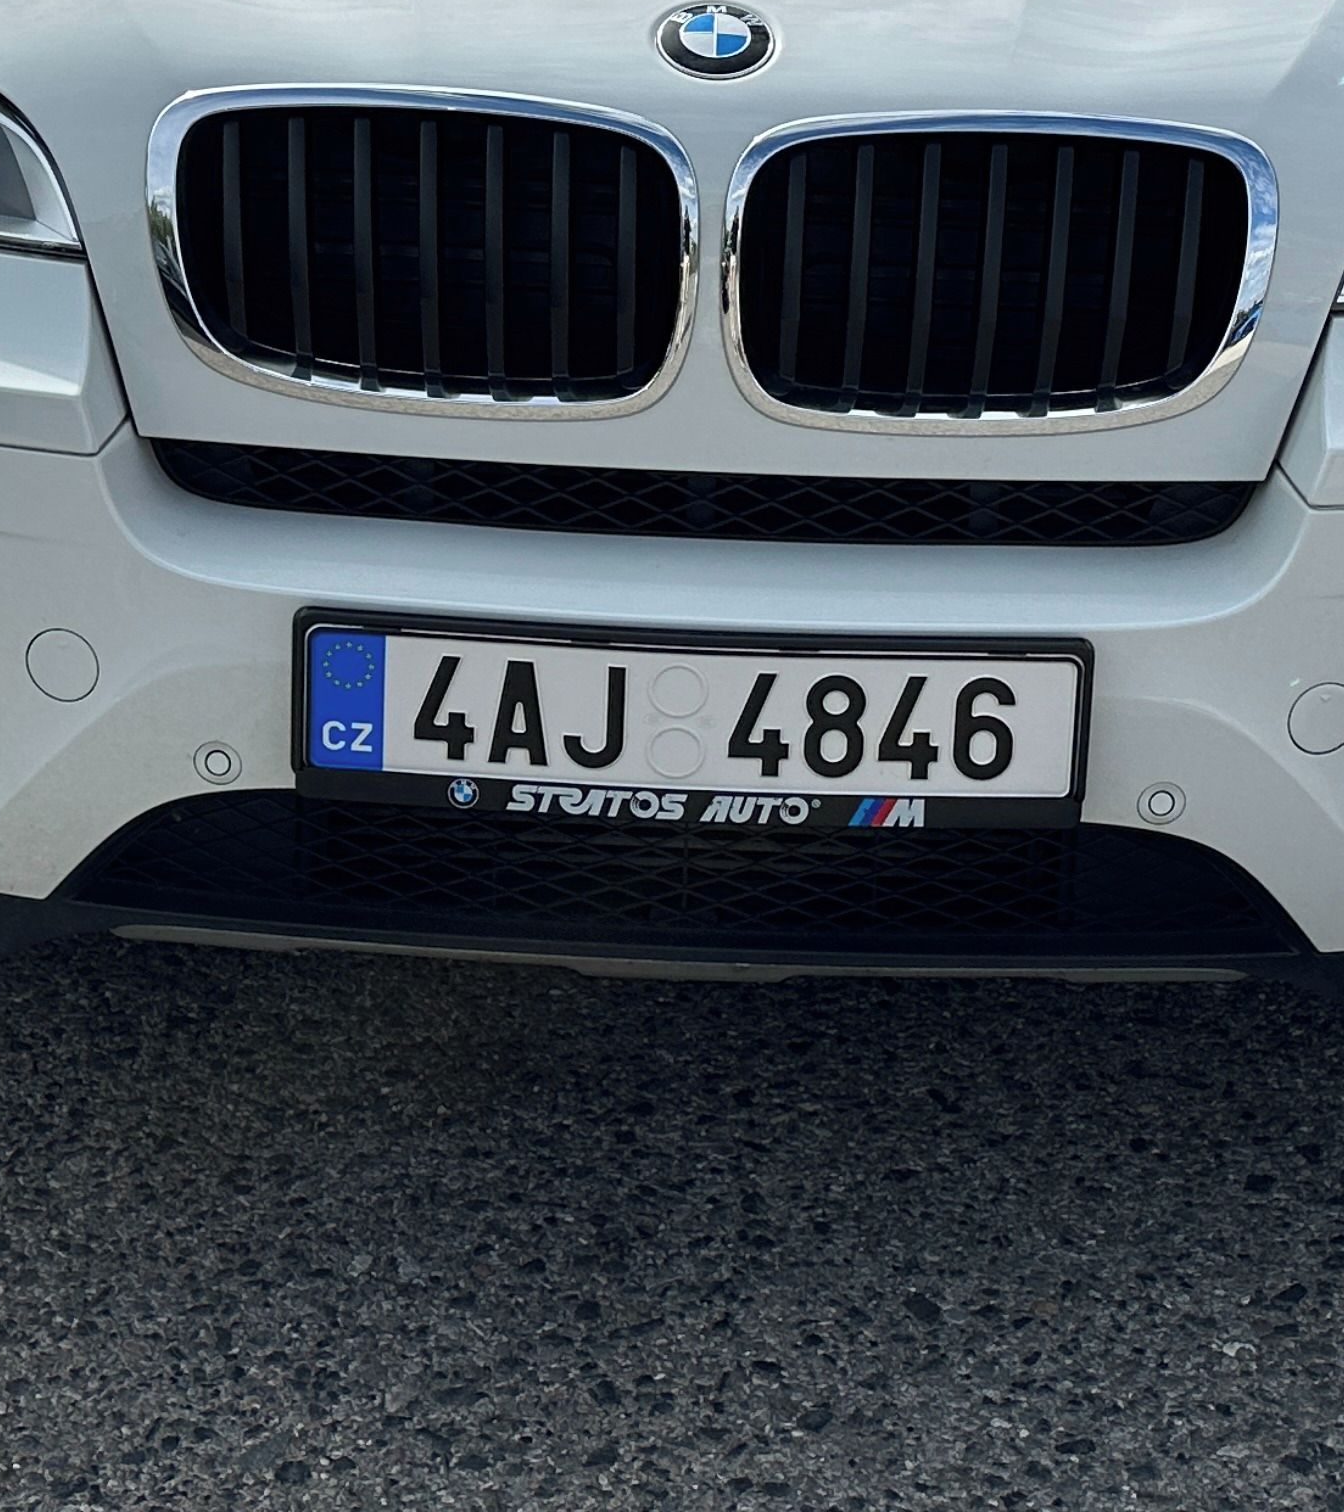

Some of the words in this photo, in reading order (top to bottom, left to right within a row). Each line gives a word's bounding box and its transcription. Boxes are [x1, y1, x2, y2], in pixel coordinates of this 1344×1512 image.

[669, 5, 764, 27] BMW
[413, 654, 627, 769] 4AJ
[727, 672, 1017, 781] 4846
[321, 720, 374, 753] CZ
[506, 783, 688, 821] STRATOS
